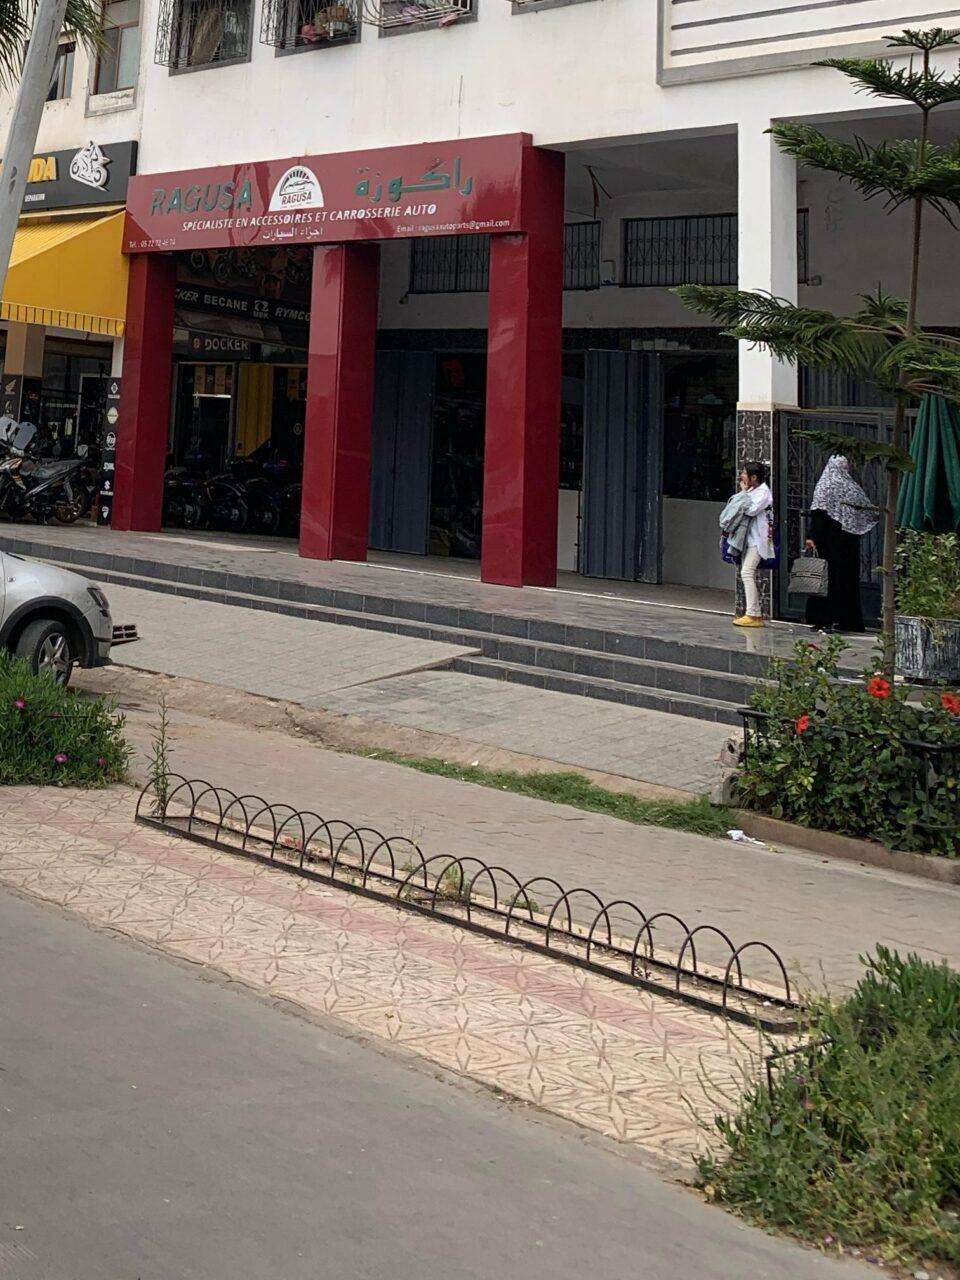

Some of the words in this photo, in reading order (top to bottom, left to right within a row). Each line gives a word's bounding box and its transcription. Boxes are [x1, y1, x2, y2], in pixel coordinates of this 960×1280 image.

[151, 179, 253, 217] RAGUSA
[281, 191, 312, 206] RAGUSA
[235, 218, 248, 228] EN
[249, 213, 313, 227] ACCESSOIRES
[314, 211, 328, 223] ET
[329, 206, 402, 221] CARROSSERIE
[403, 204, 437, 217] AUTO
[204, 294, 248, 311] BECANE
